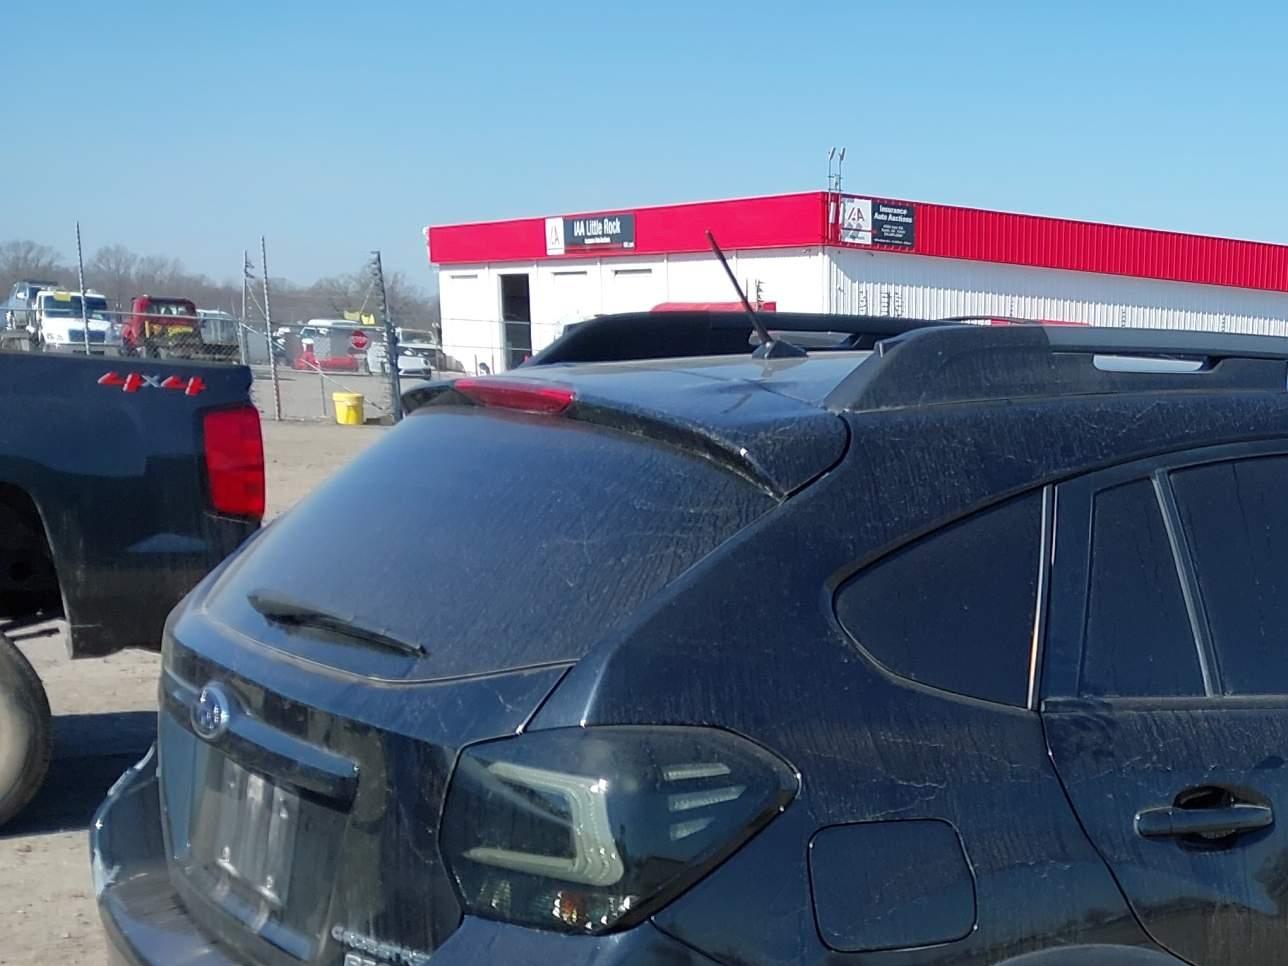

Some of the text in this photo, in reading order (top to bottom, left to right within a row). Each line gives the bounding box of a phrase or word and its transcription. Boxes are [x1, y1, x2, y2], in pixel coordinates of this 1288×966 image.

[873, 212, 912, 223] Auto Auctions
[574, 217, 621, 236] IAA Little Rock
